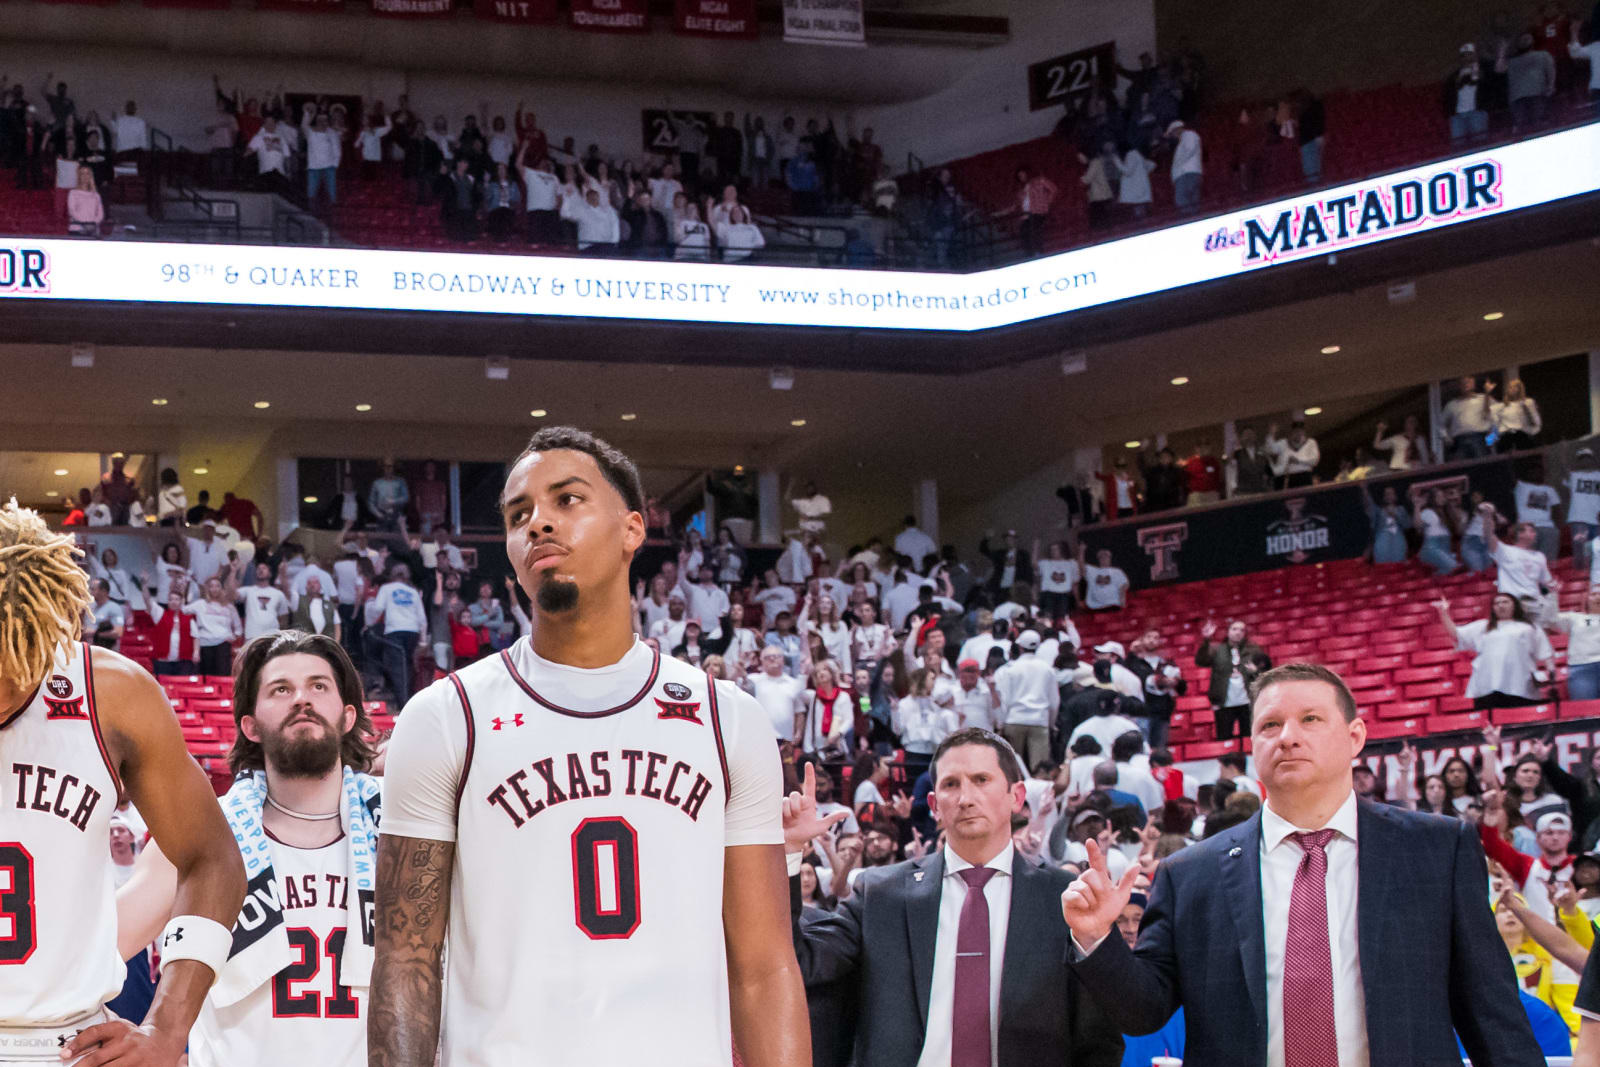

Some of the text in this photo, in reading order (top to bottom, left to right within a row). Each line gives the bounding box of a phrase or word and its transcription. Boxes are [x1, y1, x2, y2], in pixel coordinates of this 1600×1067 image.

[1204, 162, 1498, 260] the MATADOR
[223, 265, 240, 284] &
[249, 266, 360, 289] QUAKER
[393, 270, 731, 304] BROADWAY & UNIVERSITY
[1265, 527, 1330, 556] HONOR
[12, 762, 102, 833] TECH
[486, 749, 713, 829] TEXAS TECH
[570, 815, 642, 940] 0
[272, 927, 359, 1018] 21
